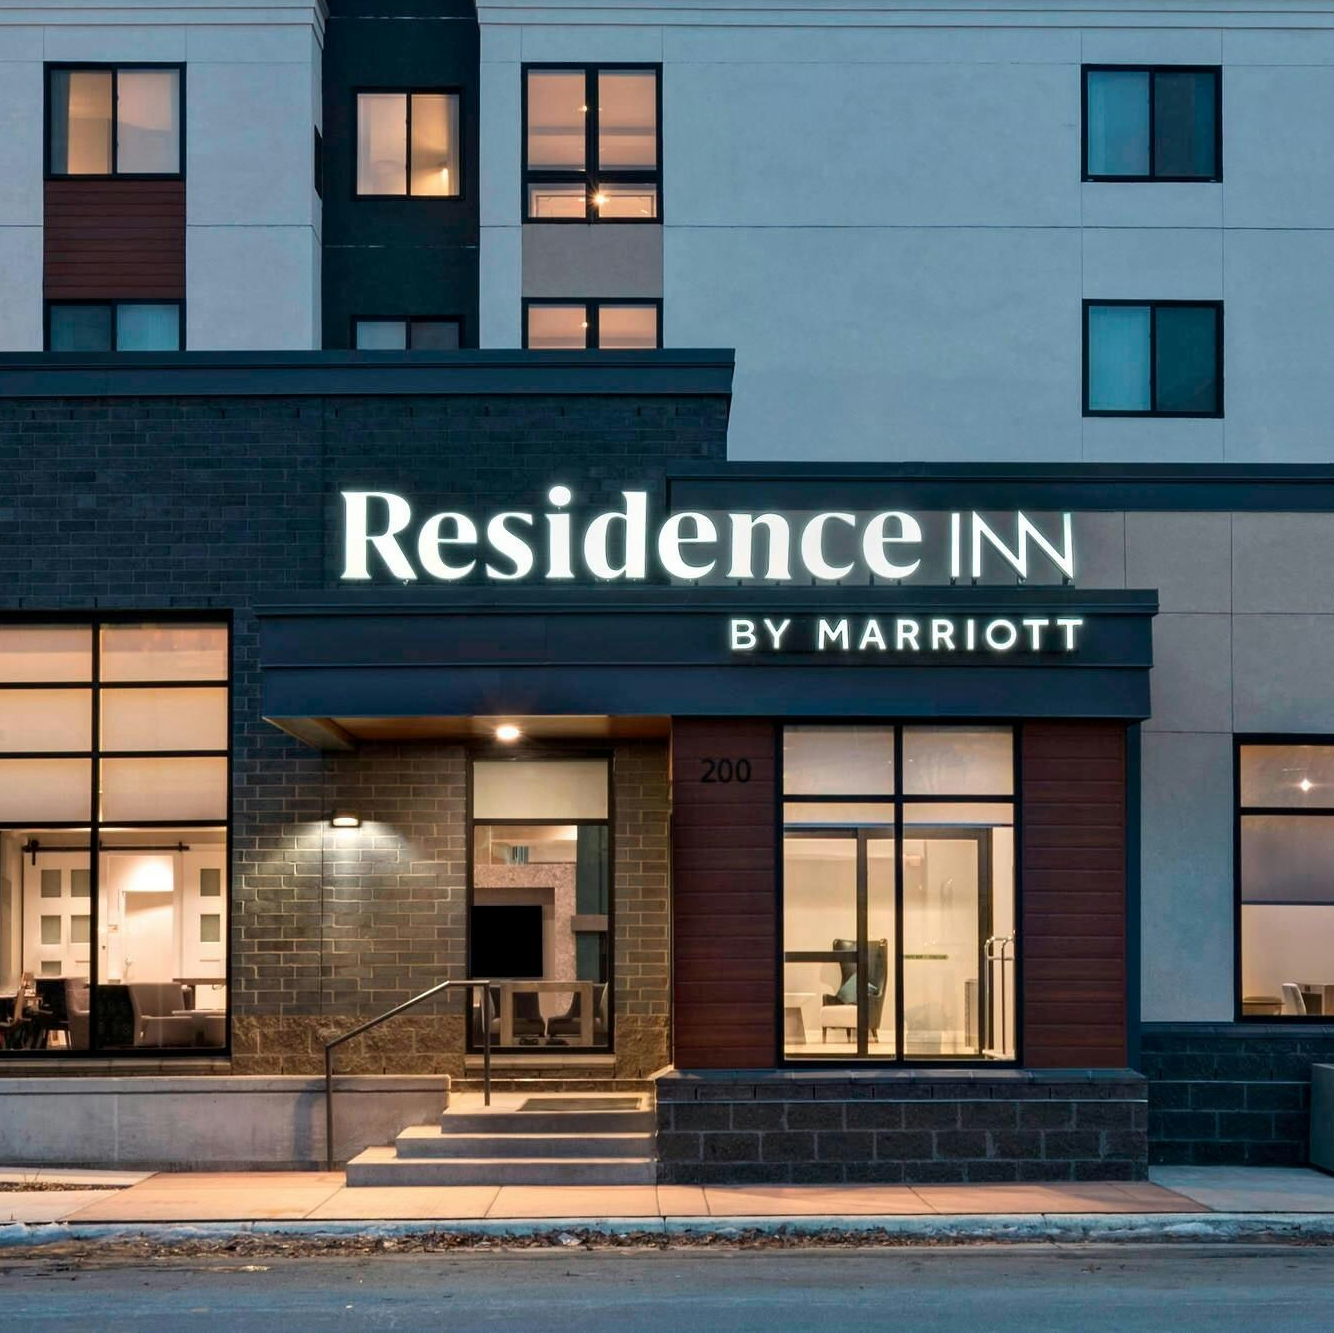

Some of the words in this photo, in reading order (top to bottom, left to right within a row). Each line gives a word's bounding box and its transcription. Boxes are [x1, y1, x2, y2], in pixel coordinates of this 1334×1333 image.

[339, 484, 923, 580] Residence
[950, 511, 1074, 579] INN
[730, 618, 791, 651] BY
[818, 618, 1084, 652] MARRIOTT
[700, 757, 752, 783] 200
